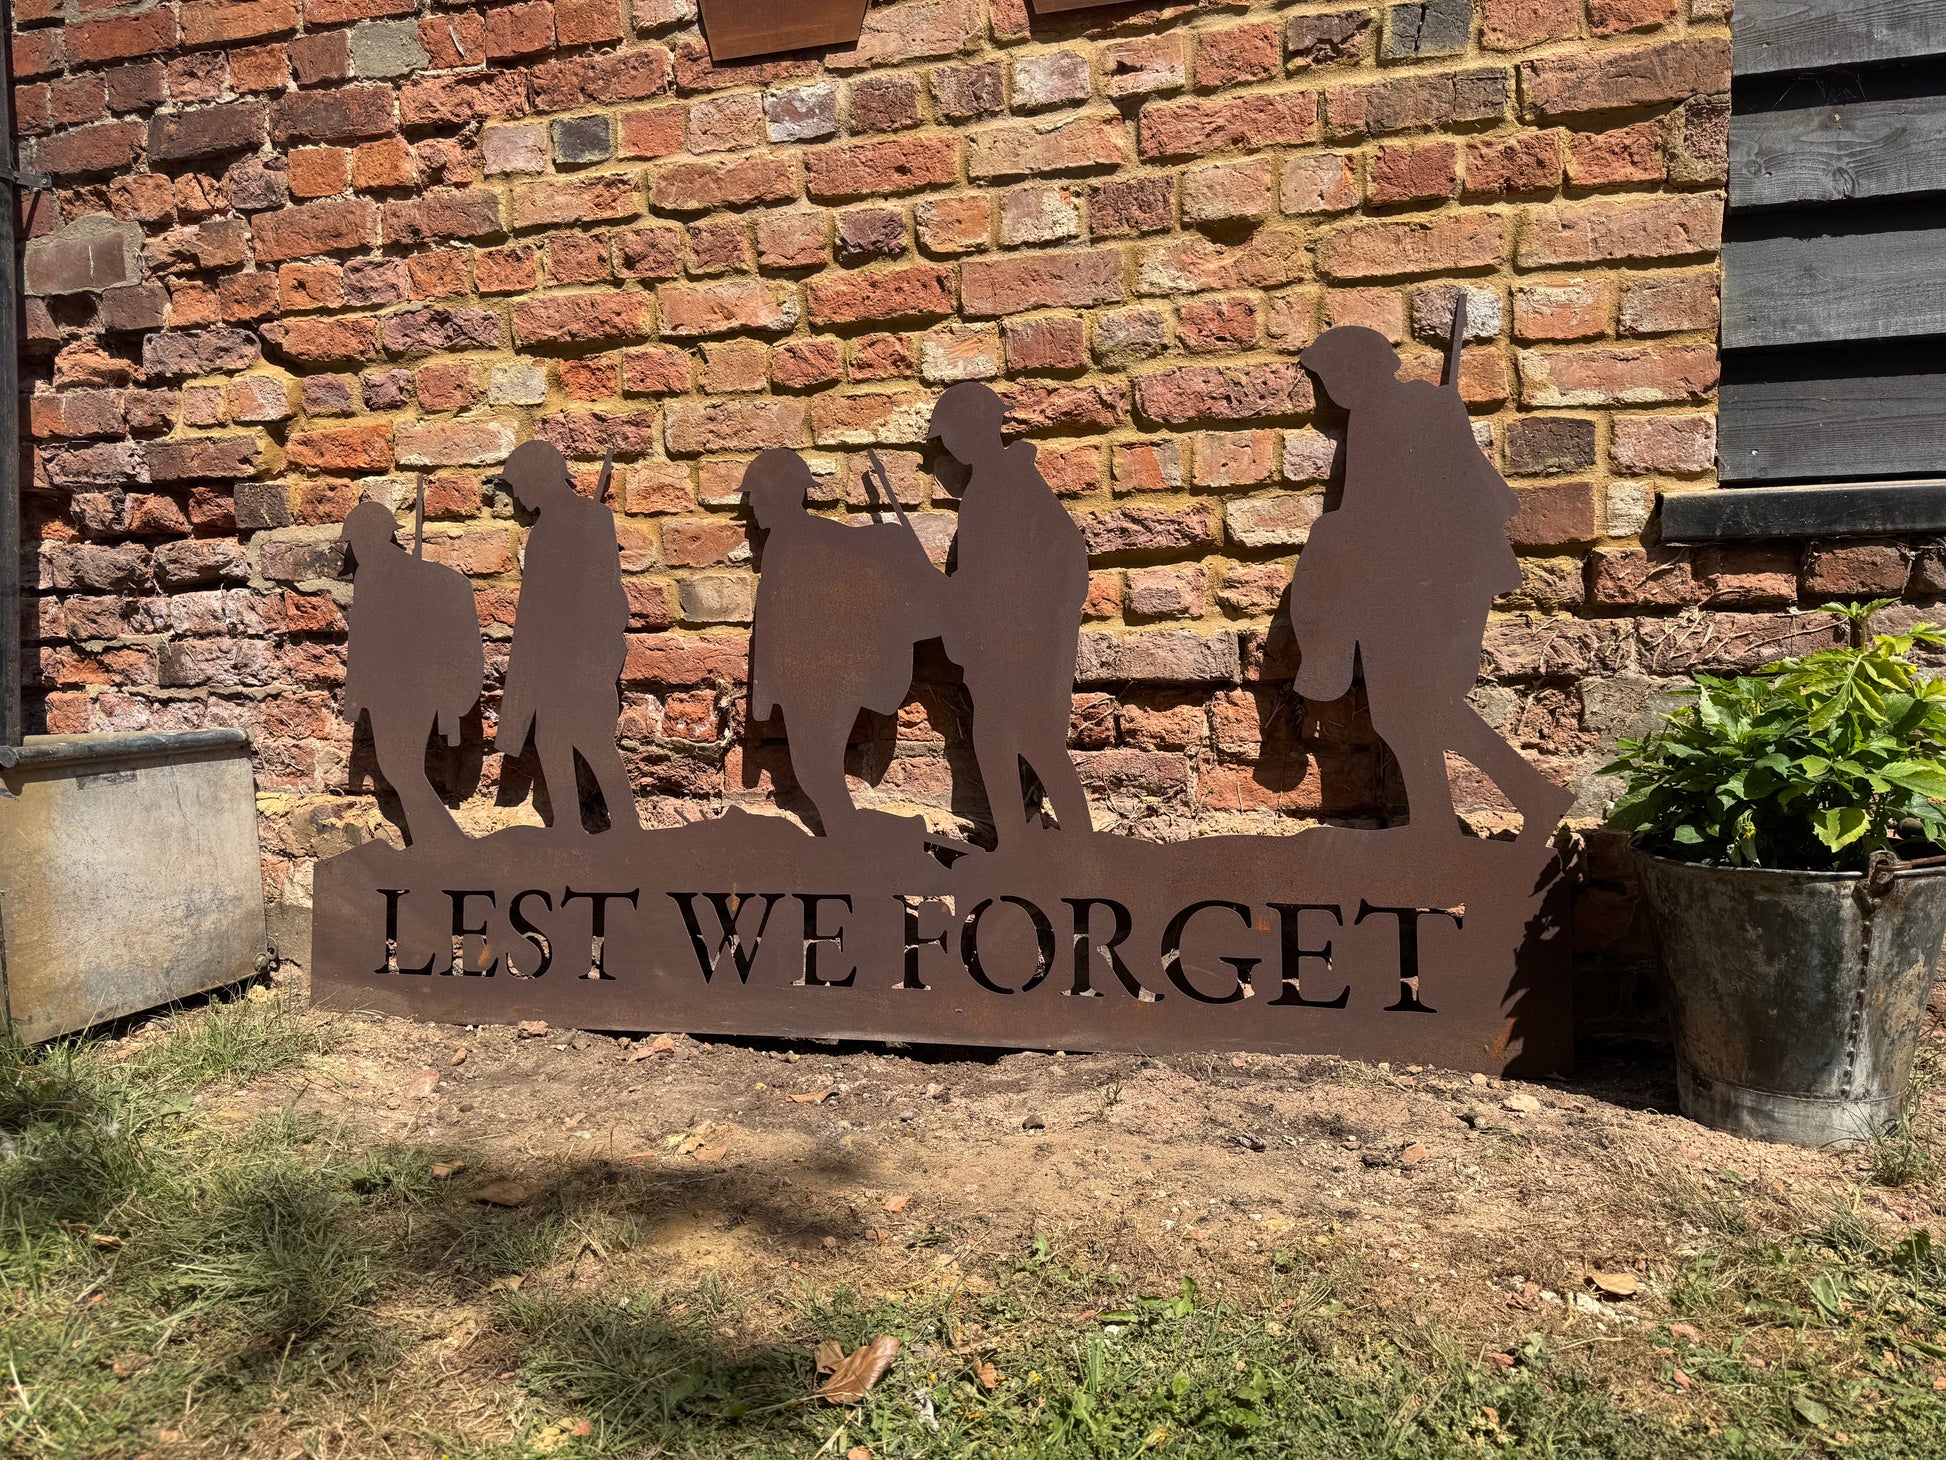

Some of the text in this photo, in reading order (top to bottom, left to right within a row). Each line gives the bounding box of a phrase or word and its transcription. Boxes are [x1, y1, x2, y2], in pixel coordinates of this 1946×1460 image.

[373, 885, 1466, 1013] LEST WE FORGET
